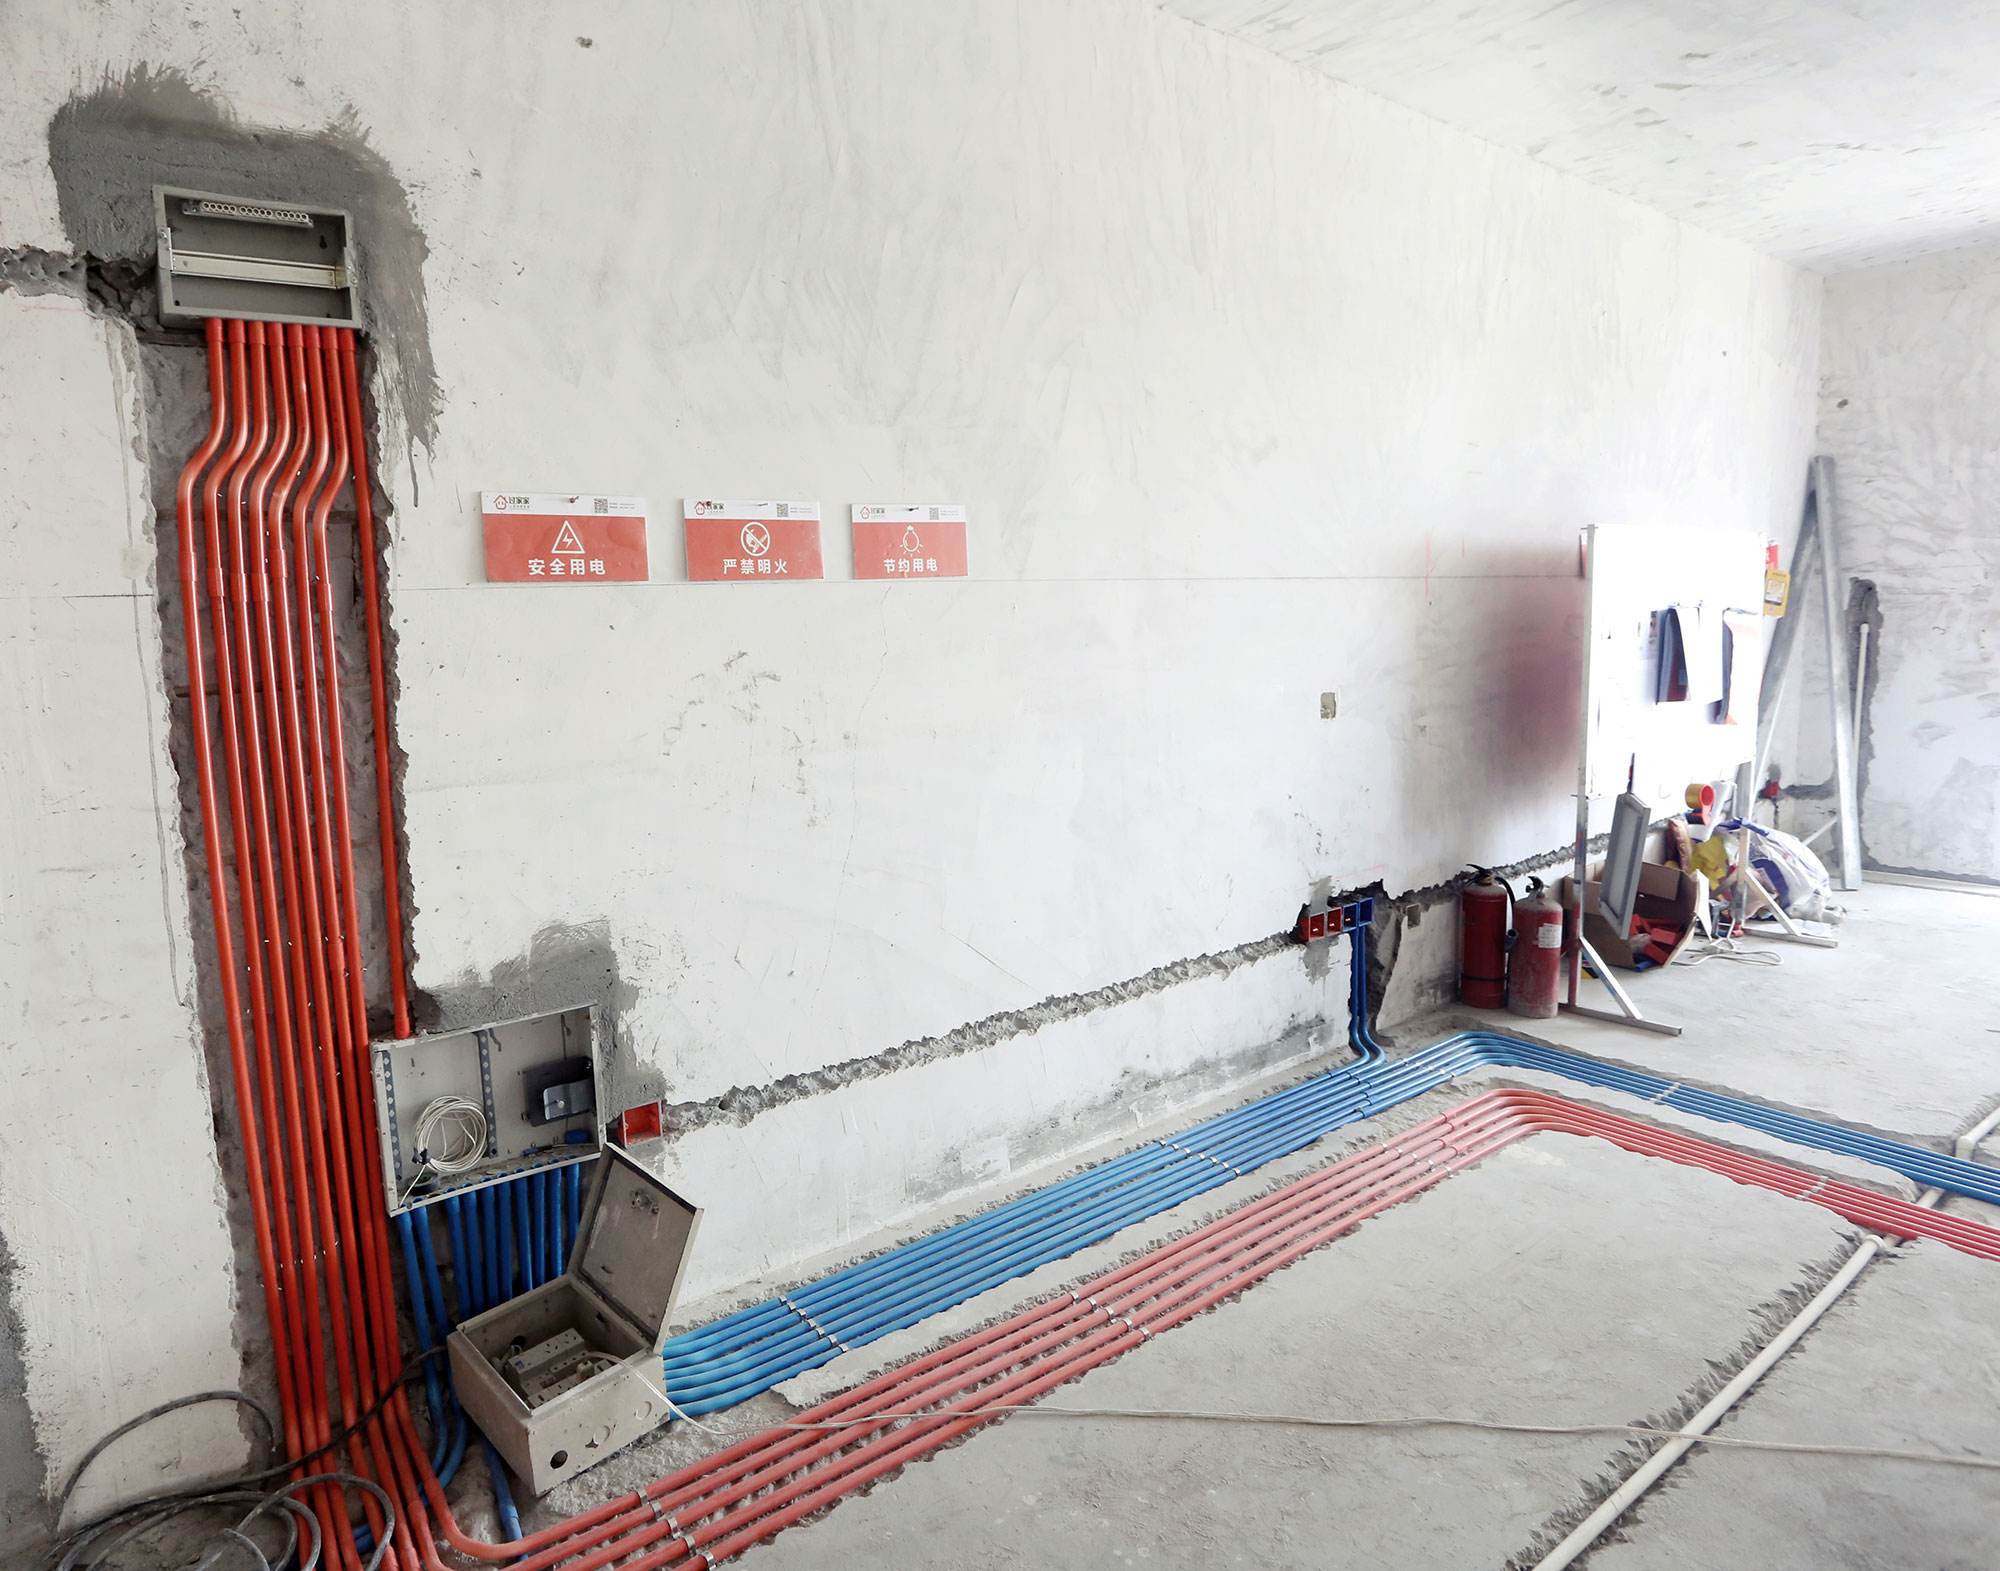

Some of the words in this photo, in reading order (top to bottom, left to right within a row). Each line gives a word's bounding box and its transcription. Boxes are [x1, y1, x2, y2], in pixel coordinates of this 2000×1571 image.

[528, 558, 606, 576] 安全用电
[722, 558, 788, 575] 严禁明火
[884, 557, 938, 573] 节约用电
